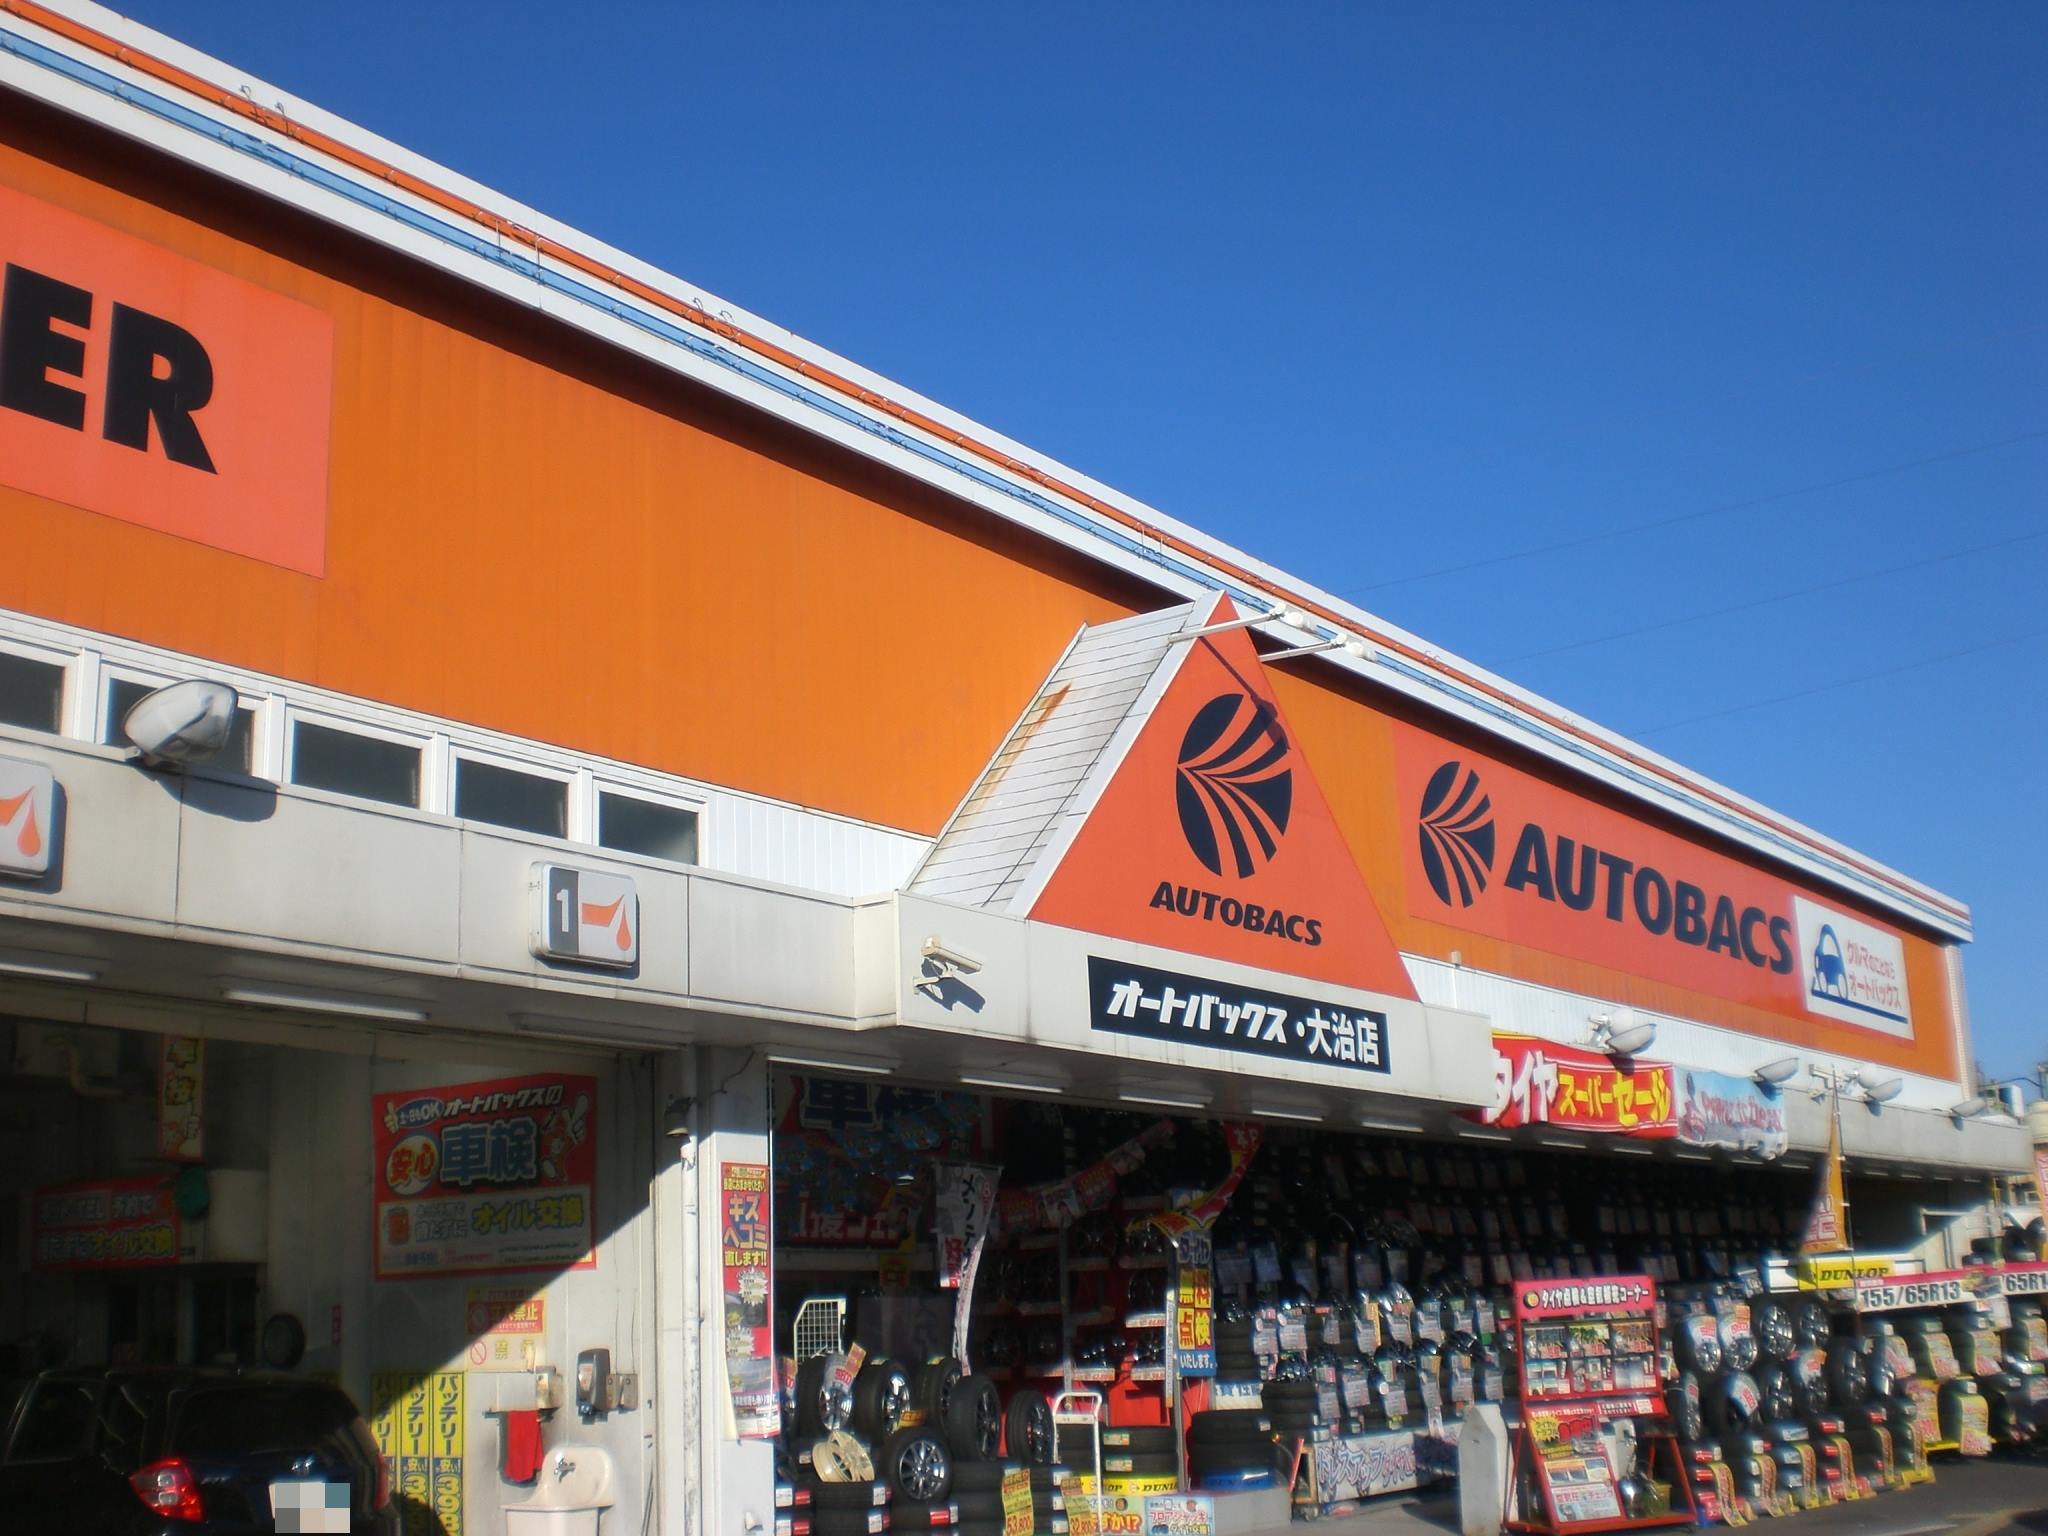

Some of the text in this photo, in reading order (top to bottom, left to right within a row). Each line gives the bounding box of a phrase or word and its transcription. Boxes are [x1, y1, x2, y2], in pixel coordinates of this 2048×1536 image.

[0, 261, 218, 475] ER
[556, 889, 569, 933] 1
[1149, 881, 1322, 946] AUTOBACS
[1504, 823, 1794, 975] AUTOBACS
[1107, 980, 1380, 1065] オートバックス・大治店
[443, 1085, 564, 1116] オートバックスの
[390, 1142, 436, 1185] 安心
[441, 1117, 537, 1186] 車検
[472, 1195, 584, 1235] オイル交換
[729, 1195, 760, 1222] キズ
[723, 1223, 768, 1250] ヘコミ
[1819, 1266, 1889, 1282] DUNLOP
[1860, 1281, 1962, 1308] 155/65R13
[1178, 1311, 1212, 1348] 点検
[406, 1375, 425, 1455] バッテリー
[437, 1375, 458, 1455] バッテリー
